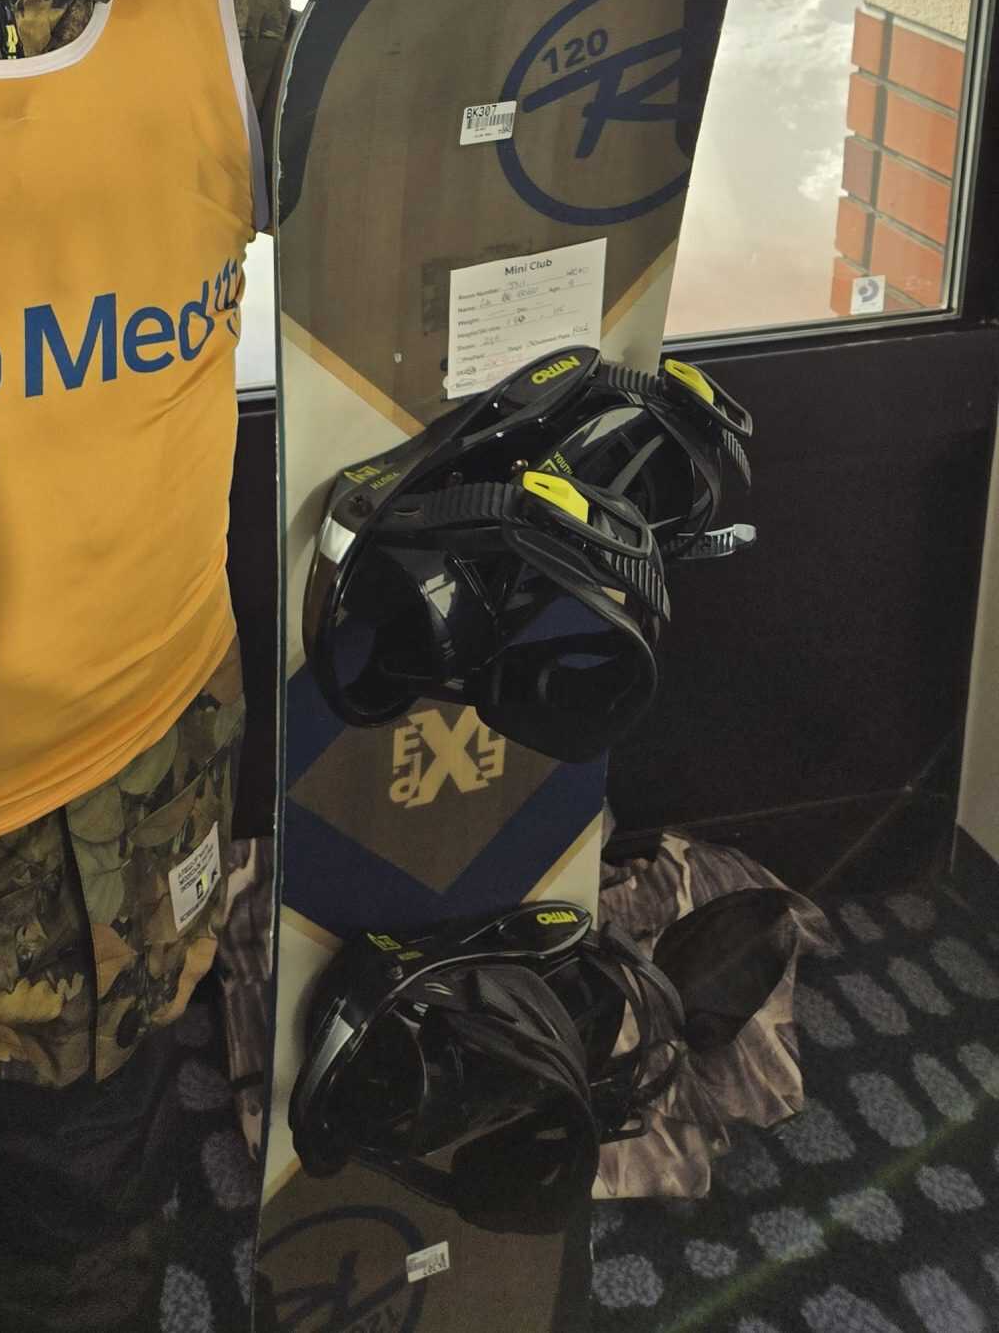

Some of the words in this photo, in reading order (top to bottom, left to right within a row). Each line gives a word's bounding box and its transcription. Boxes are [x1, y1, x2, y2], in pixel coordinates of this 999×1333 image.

[541, 28, 609, 74] 120
[505, 262, 528, 276] Mini
[529, 259, 552, 271] Club
[23, 279, 215, 398] Med
[531, 356, 581, 385] NITRO
[536, 910, 579, 925] NITRO
